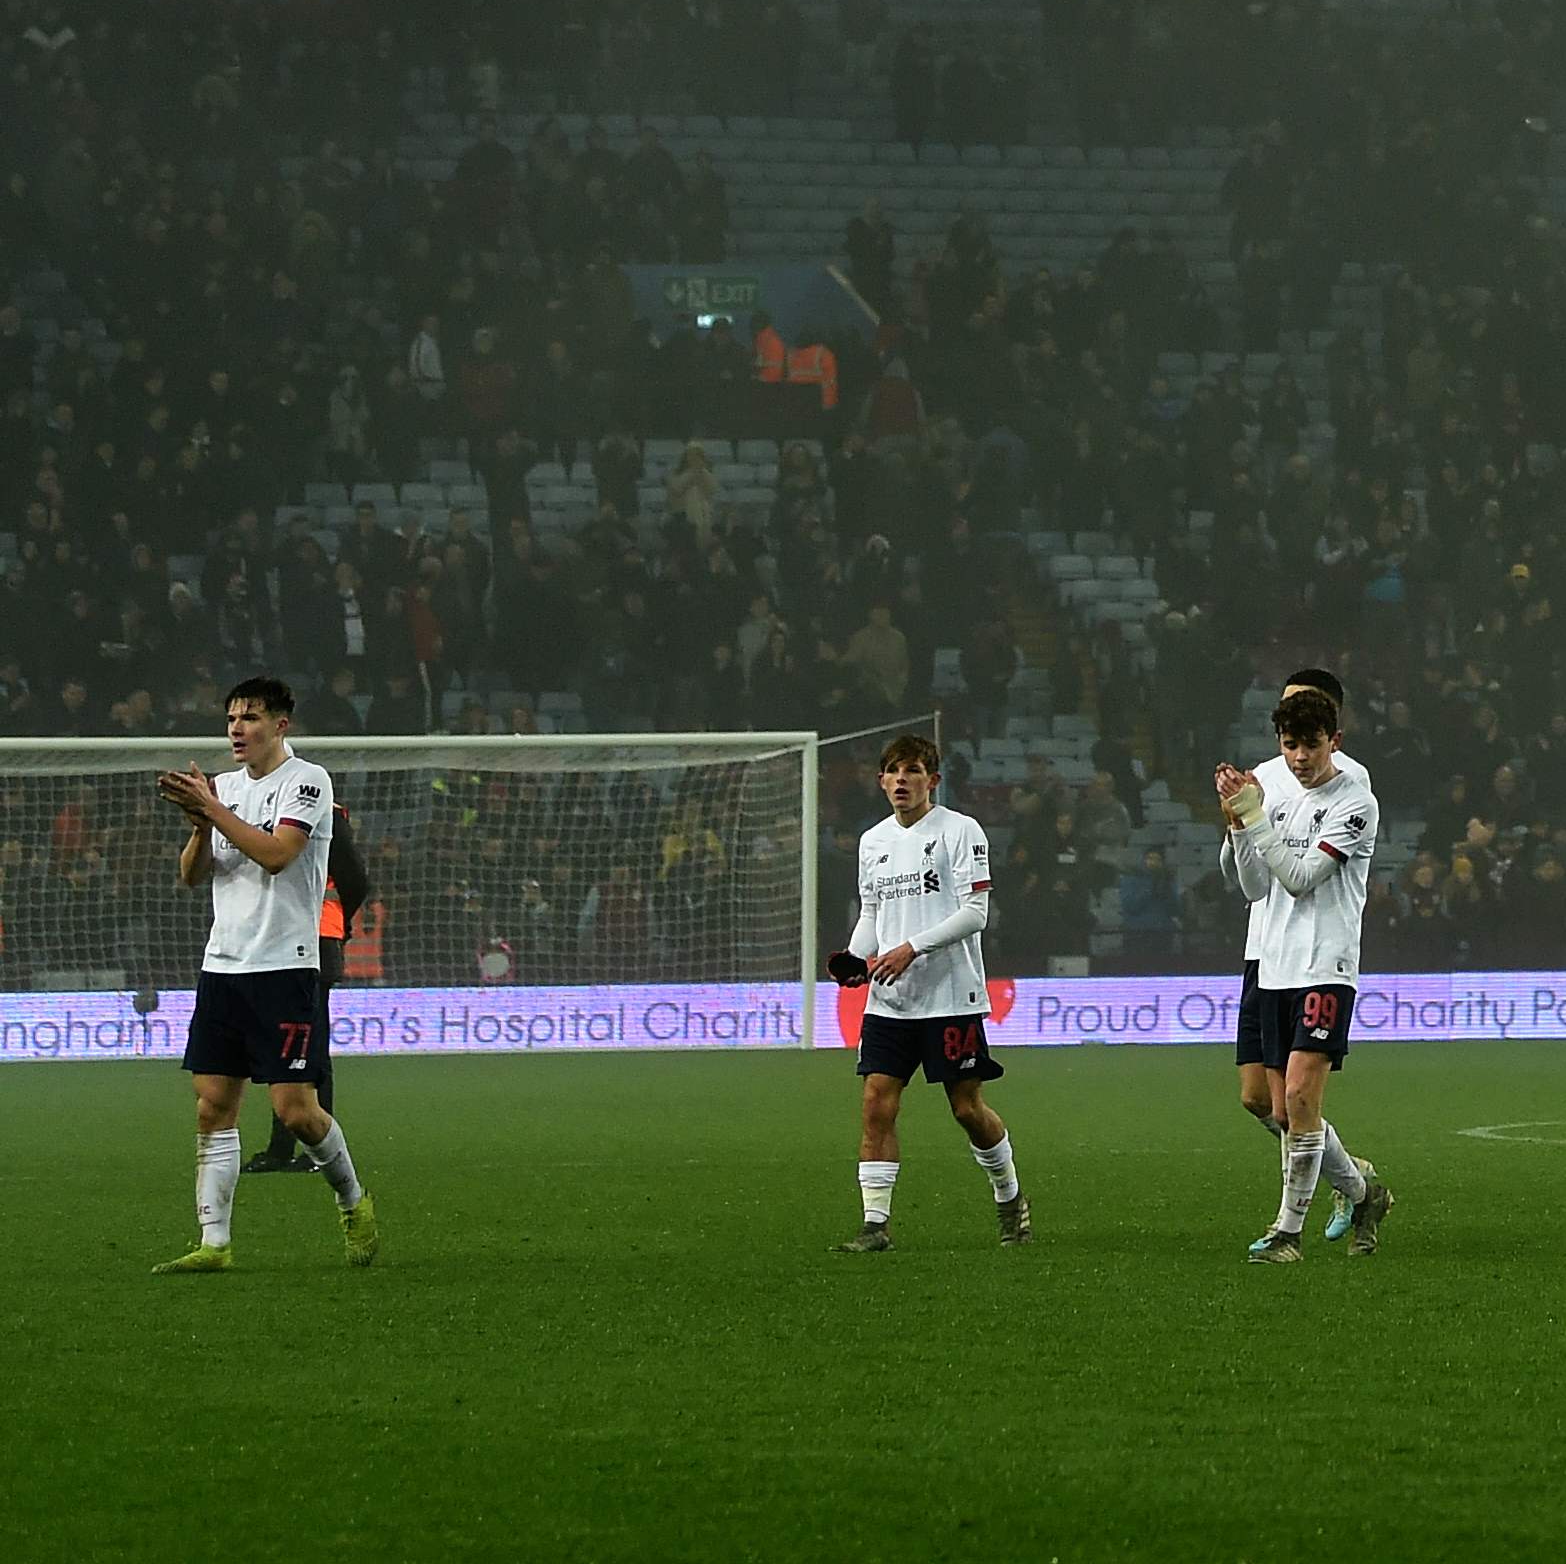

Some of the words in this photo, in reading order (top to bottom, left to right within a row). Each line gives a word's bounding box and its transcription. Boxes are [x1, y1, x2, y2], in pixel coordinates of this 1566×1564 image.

[877, 870, 921, 888] Standard
[878, 885, 922, 902] Chartered
[1036, 994, 1161, 1033] Proud
[1355, 990, 1516, 1039] Charity
[1303, 991, 1340, 1029] 99
[1, 1010, 172, 1057] ngham
[439, 1002, 625, 1048] Hospital
[278, 1022, 312, 1059] 77
[943, 1023, 977, 1061] 84
